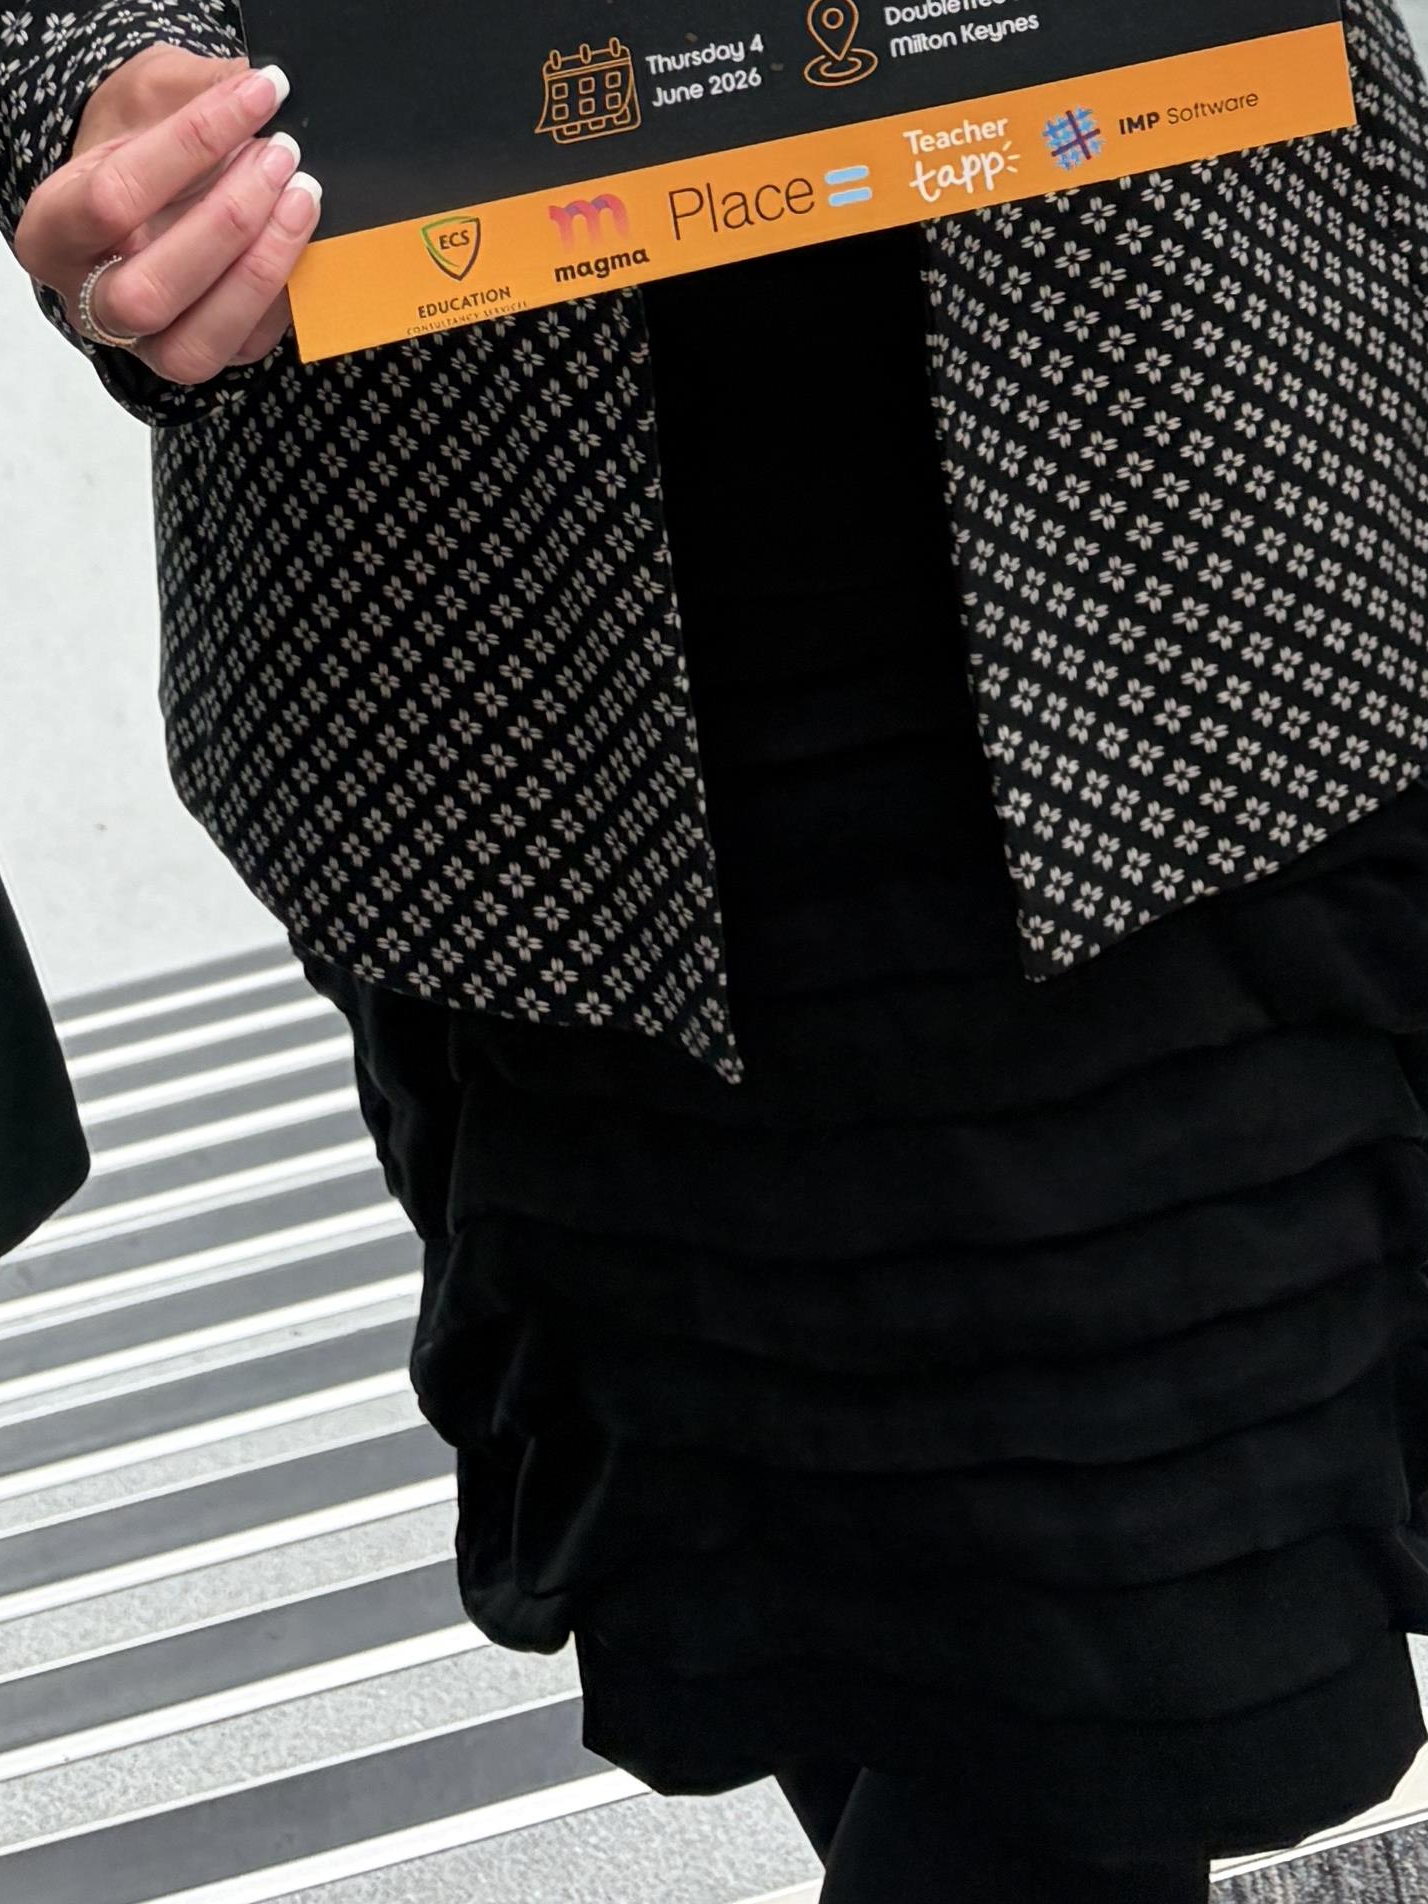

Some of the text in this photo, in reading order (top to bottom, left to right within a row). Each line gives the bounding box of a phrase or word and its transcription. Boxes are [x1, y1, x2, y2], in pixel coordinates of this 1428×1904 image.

[646, 33, 765, 75] Thursday 4
[890, 12, 1040, 58] Milton Keynes
[651, 67, 763, 108] June 2026
[1118, 90, 1260, 136] IMP Software
[903, 115, 1009, 155] Teacher
[909, 150, 1007, 203] tapp
[668, 177, 815, 240] Place
[439, 230, 470, 250] ECS
[554, 247, 650, 283] magma
[418, 286, 512, 319] EDUCATION
